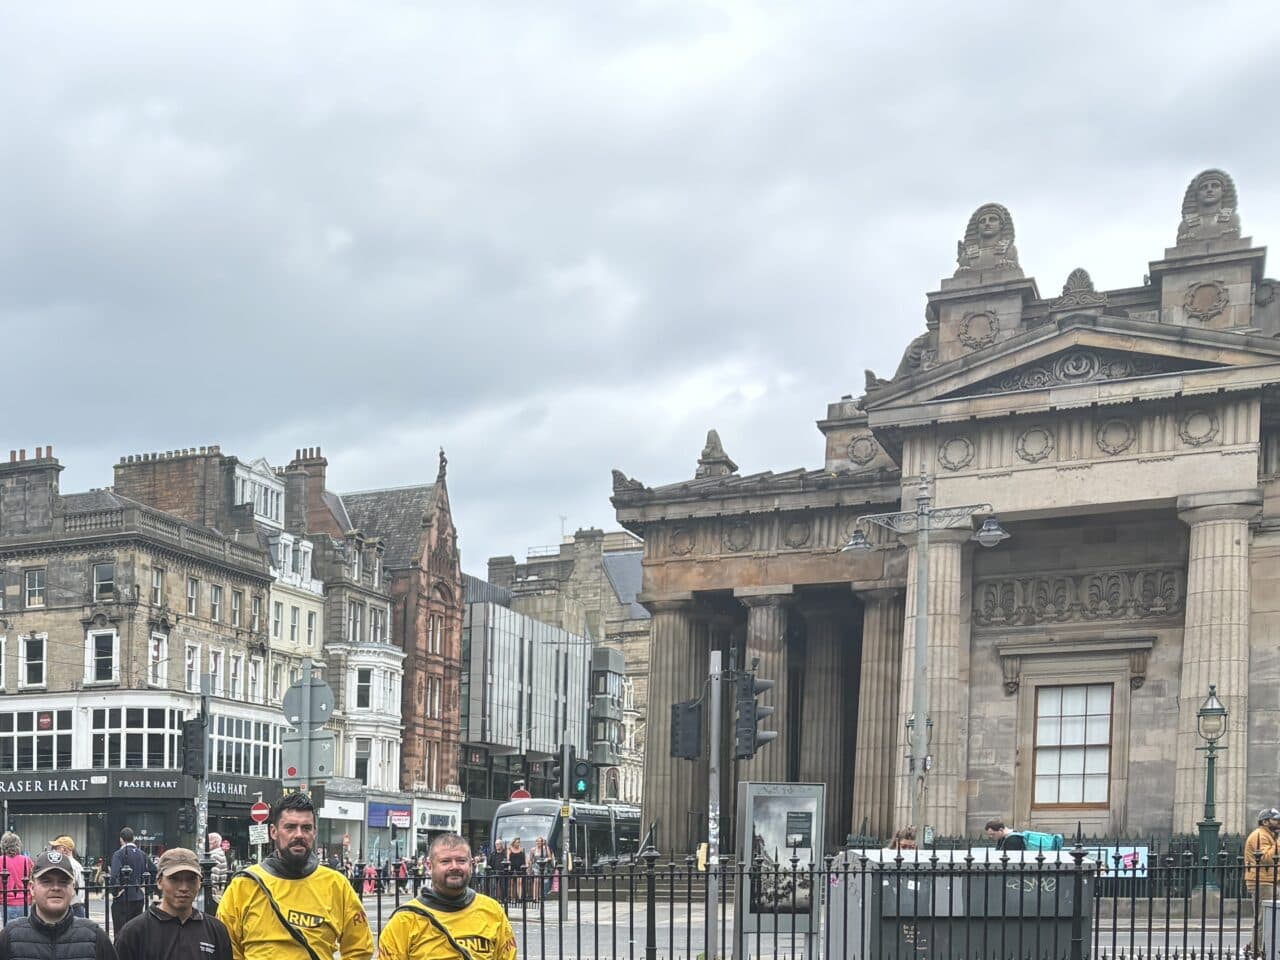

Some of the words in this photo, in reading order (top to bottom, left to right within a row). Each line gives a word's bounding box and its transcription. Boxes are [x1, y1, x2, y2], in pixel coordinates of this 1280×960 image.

[48, 779, 89, 791] HART
[119, 780, 152, 788] FRASER
[153, 780, 178, 788] HART
[227, 784, 248, 796] HART
